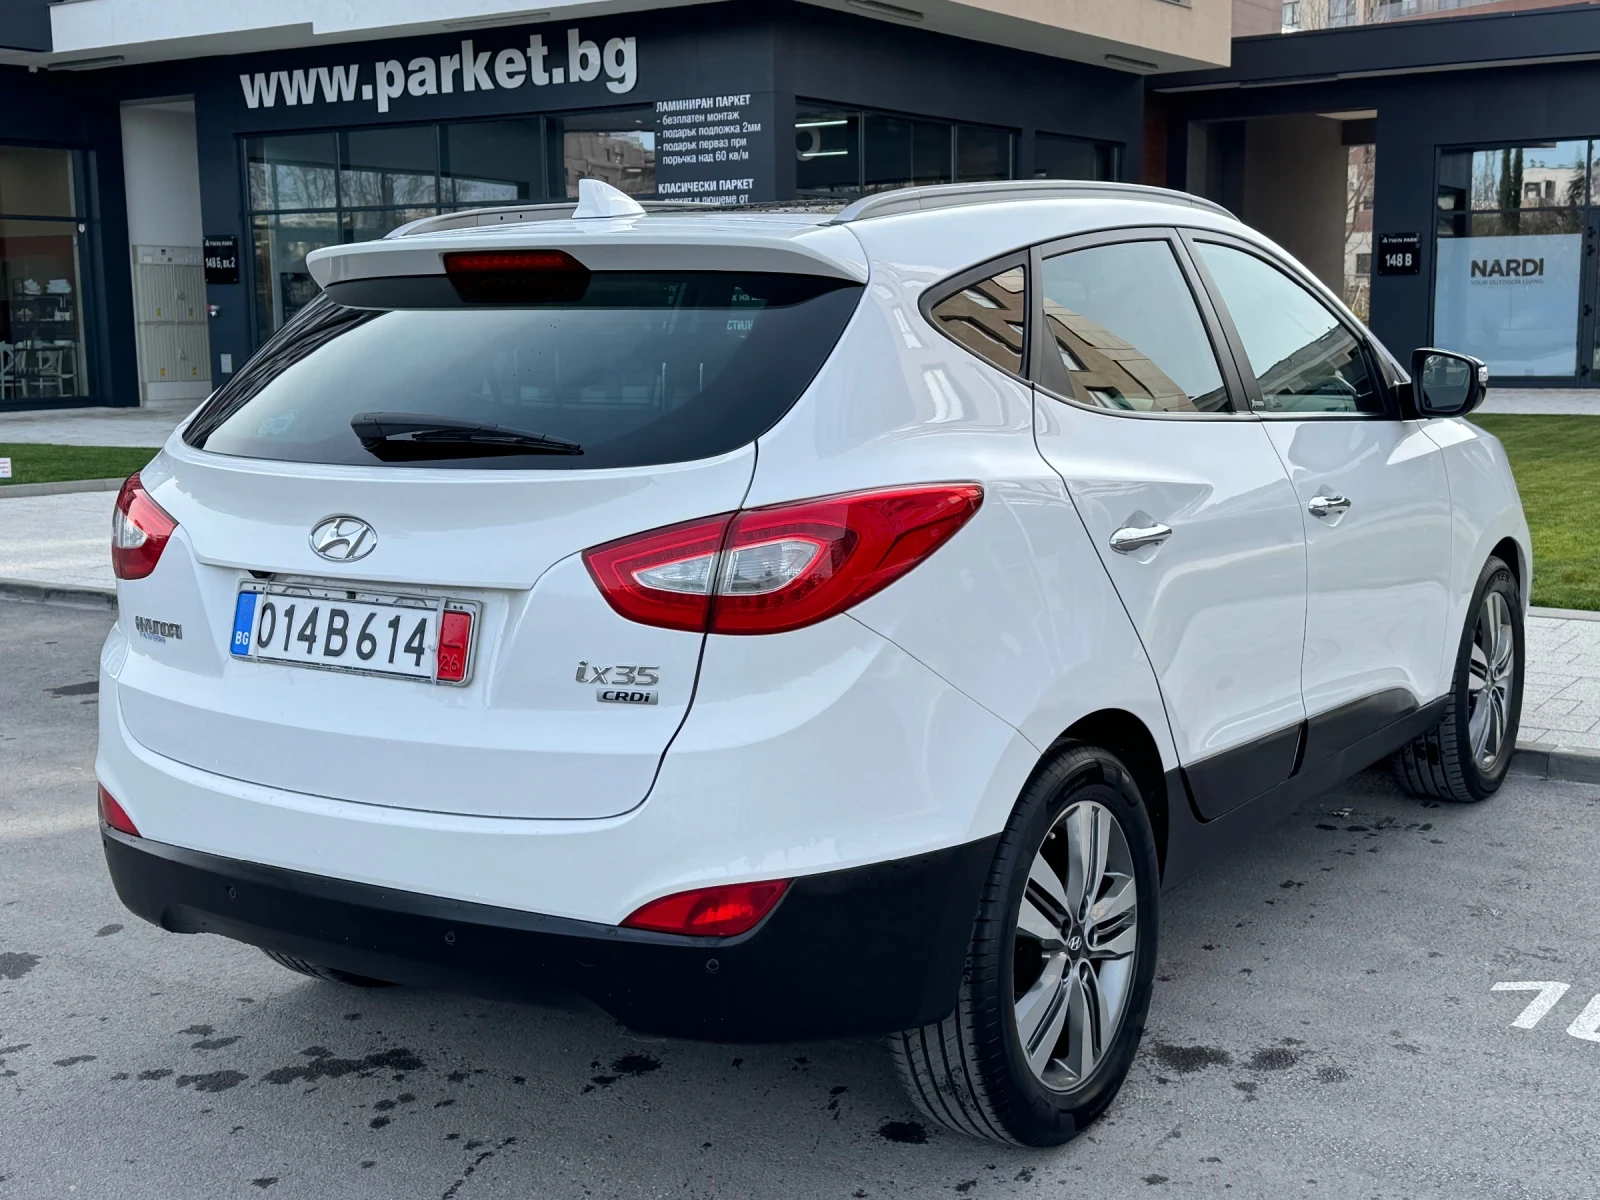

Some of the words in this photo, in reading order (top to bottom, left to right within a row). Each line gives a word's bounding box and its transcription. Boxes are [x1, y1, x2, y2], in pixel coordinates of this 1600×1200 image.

[239, 28, 637, 113] www.parket.bg
[655, 97, 714, 113] ЛАМИНИРАН
[715, 94, 751, 108] ПАРКЕТ
[662, 114, 705, 125] безплатен
[706, 111, 740, 122] монтаж
[698, 124, 741, 136] подложка
[742, 122, 761, 133] 2мм
[698, 139, 729, 150] перваз
[730, 138, 747, 149] при
[698, 153, 714, 163] над
[715, 150, 727, 161] 60
[728, 149, 749, 161] кв/м
[658, 181, 717, 194] КЛАСИЧЕСКИ
[719, 179, 754, 190] ПАРКЕТ
[738, 194, 749, 204] от
[1385, 253, 1404, 267] 148
[1470, 258, 1545, 277] NARDI
[235, 631, 249, 646] BG
[257, 601, 428, 667] 014B614
[439, 653, 460, 673] 26
[575, 659, 660, 686] ix35
[602, 690, 651, 703] CRDi
